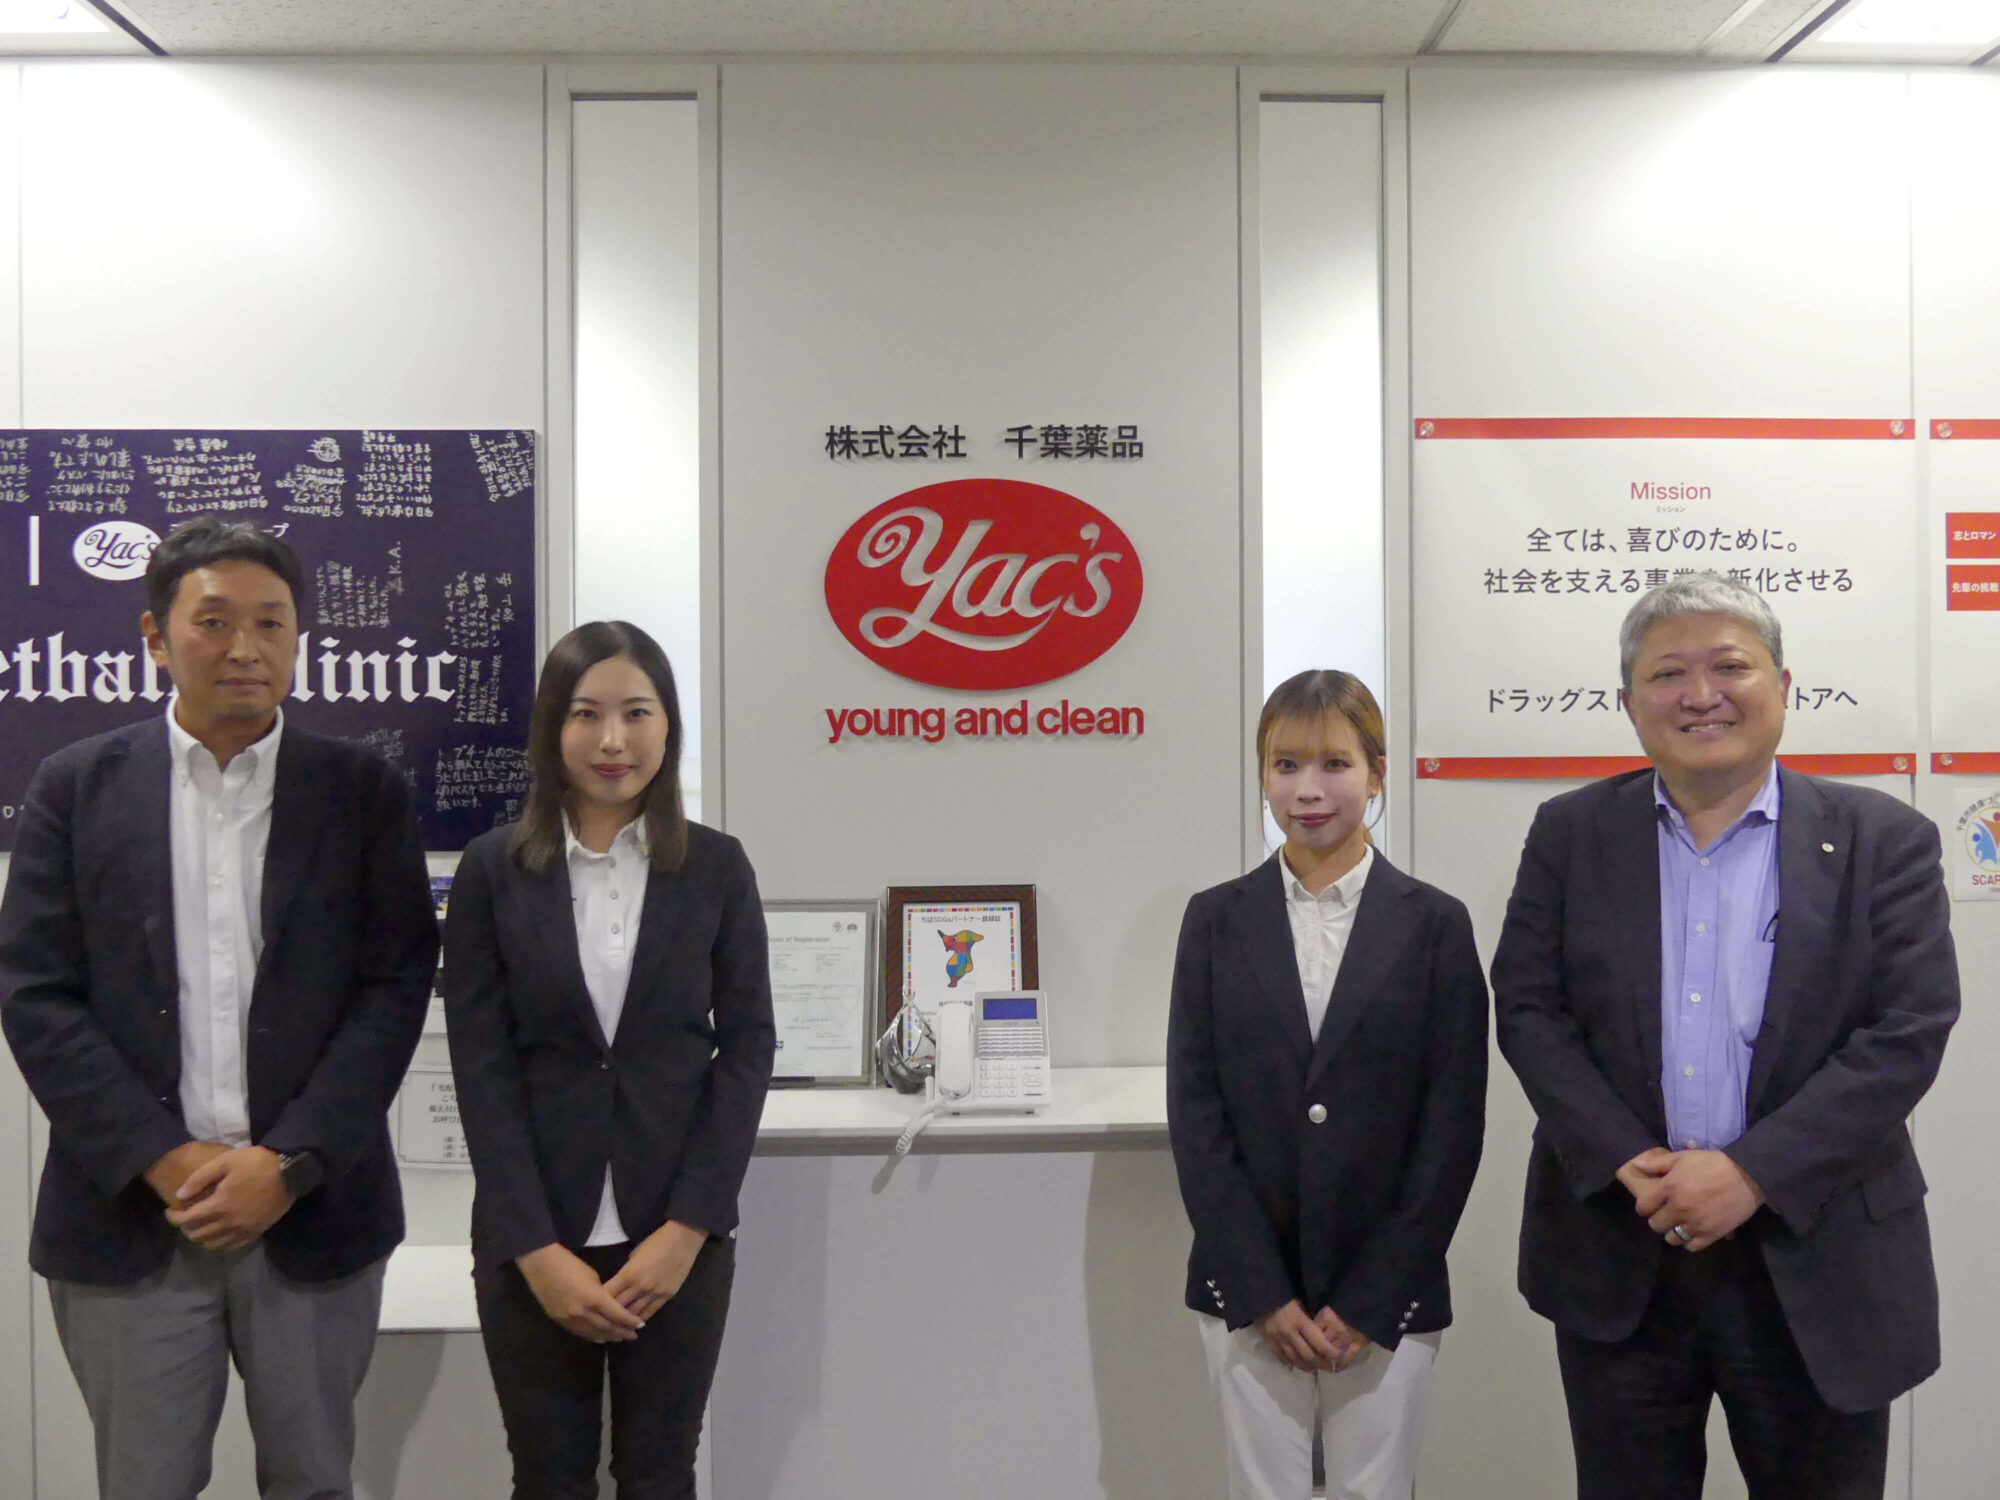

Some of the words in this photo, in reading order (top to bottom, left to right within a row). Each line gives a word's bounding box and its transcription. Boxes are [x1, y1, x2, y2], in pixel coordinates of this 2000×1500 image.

[826, 425, 967, 459] 株式会社
[1004, 425, 1144, 459] 千葉薬品
[1630, 482, 1712, 501] Mission
[1526, 527, 1797, 554] 全ては、喜びのために。
[1953, 530, 1997, 541] 志とロマン
[856, 506, 1122, 651] Yac's
[826, 708, 945, 743] young
[955, 700, 1028, 736] and
[1036, 700, 1145, 736] clean
